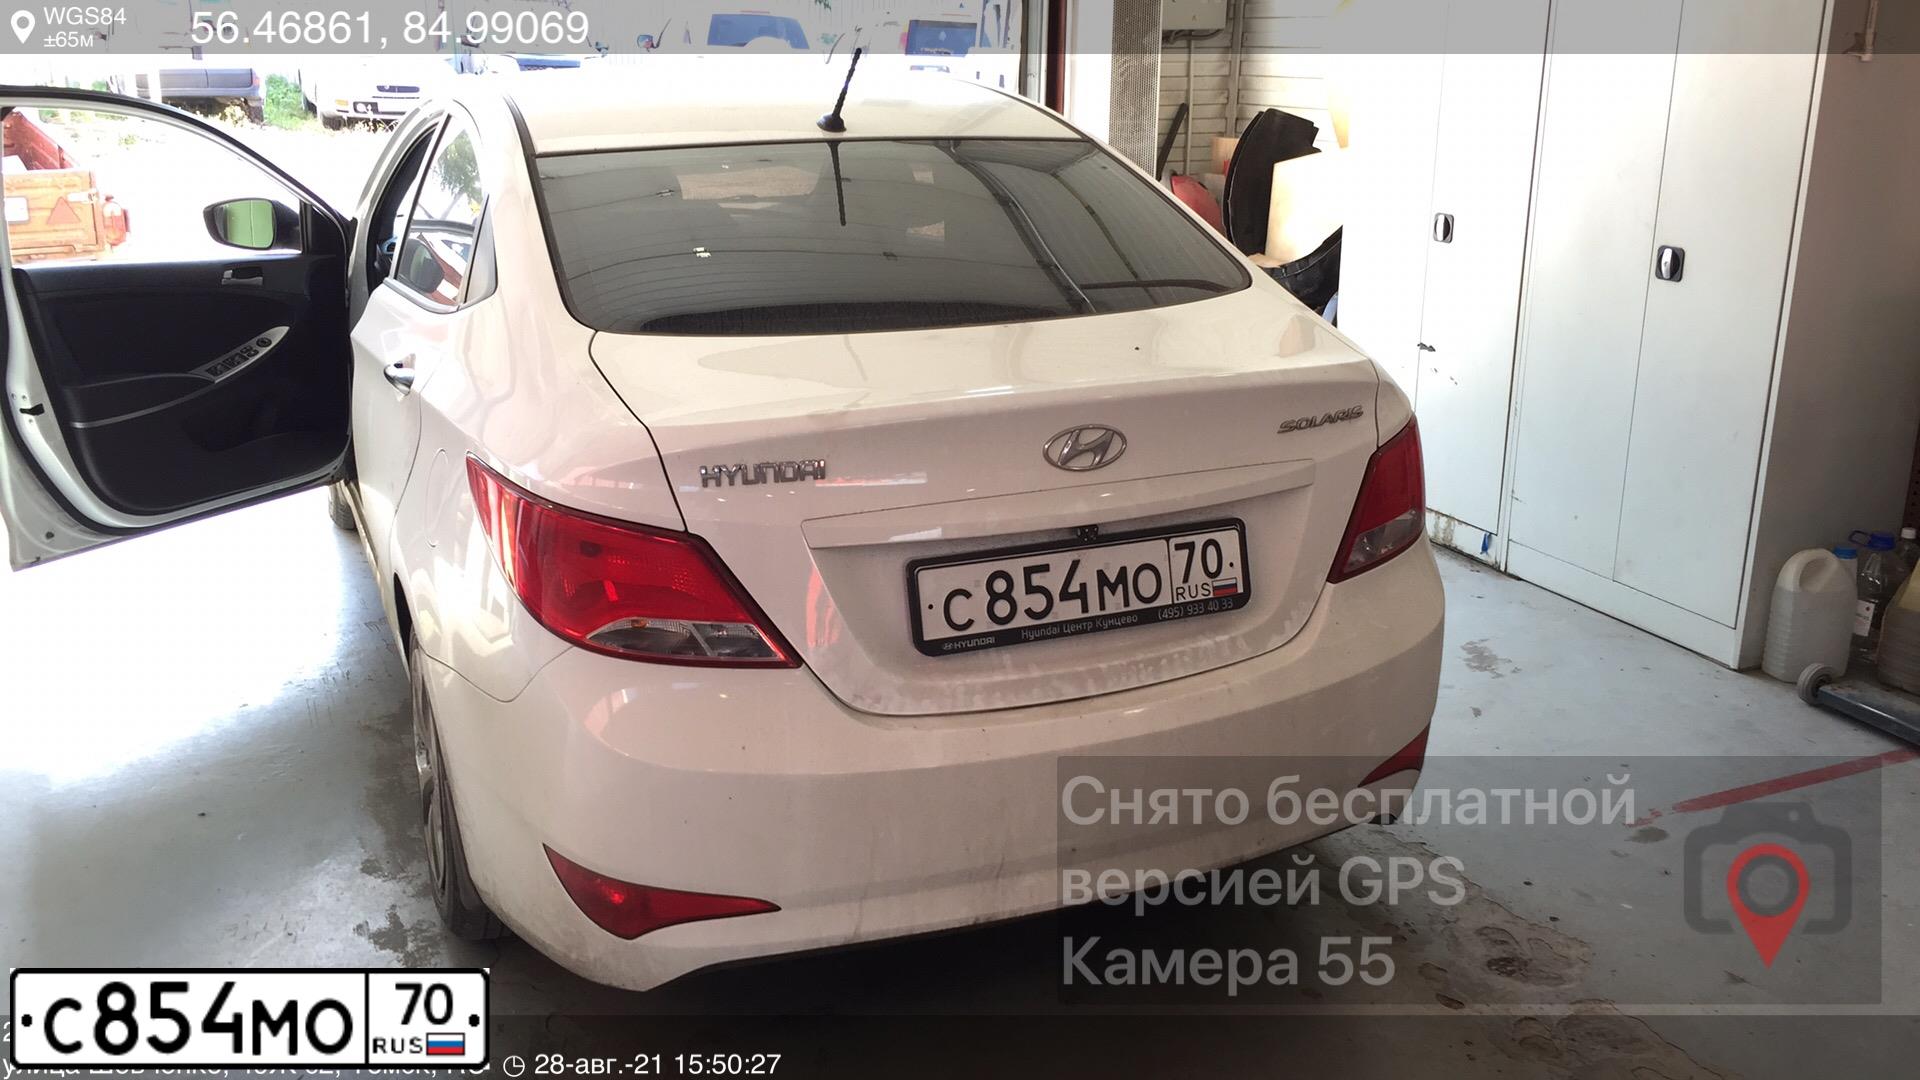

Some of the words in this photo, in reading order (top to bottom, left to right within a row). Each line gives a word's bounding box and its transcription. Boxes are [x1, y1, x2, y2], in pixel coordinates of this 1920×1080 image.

[1277, 404, 1364, 434] SOLARIS
[699, 457, 826, 488] HYUNDAI
[1174, 538, 1223, 585] 70
[1175, 582, 1211, 601] RUS
[1021, 623, 1061, 640] Hyundai
[1063, 620, 1093, 634] Центр
[1095, 614, 1139, 629] Кунцево
[953, 636, 996, 649] HYUNDAI
